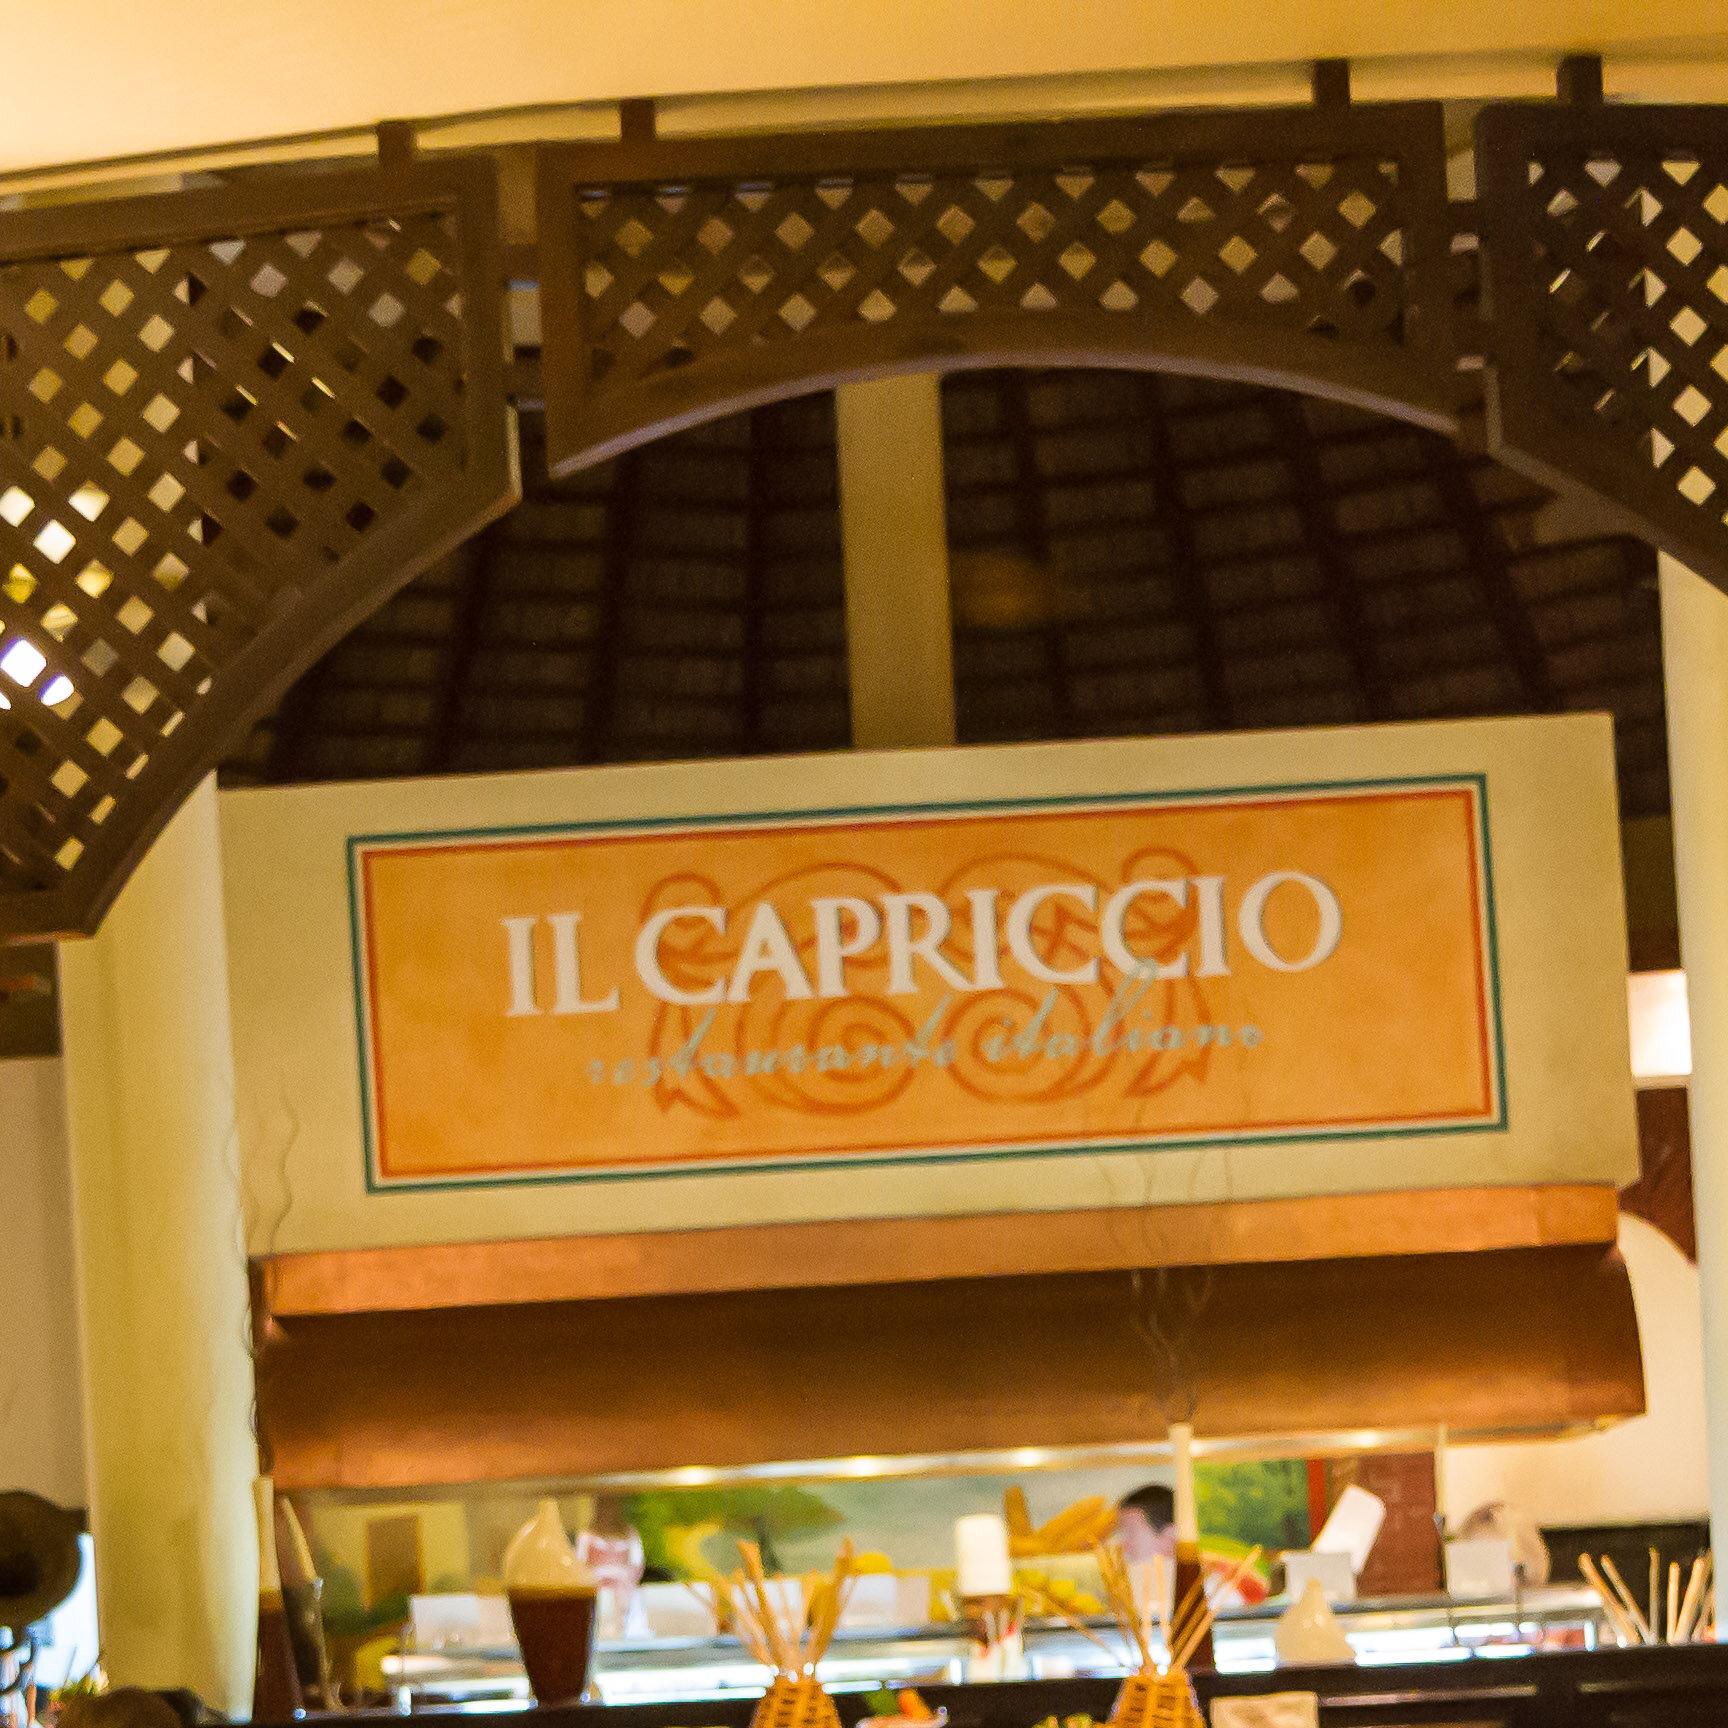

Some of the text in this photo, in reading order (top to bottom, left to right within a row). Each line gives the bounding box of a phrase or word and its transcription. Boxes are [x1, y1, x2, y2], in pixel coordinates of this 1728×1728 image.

[500, 870, 1344, 1018] IL CAPRICCIO
[980, 957, 1266, 1063] italiano
